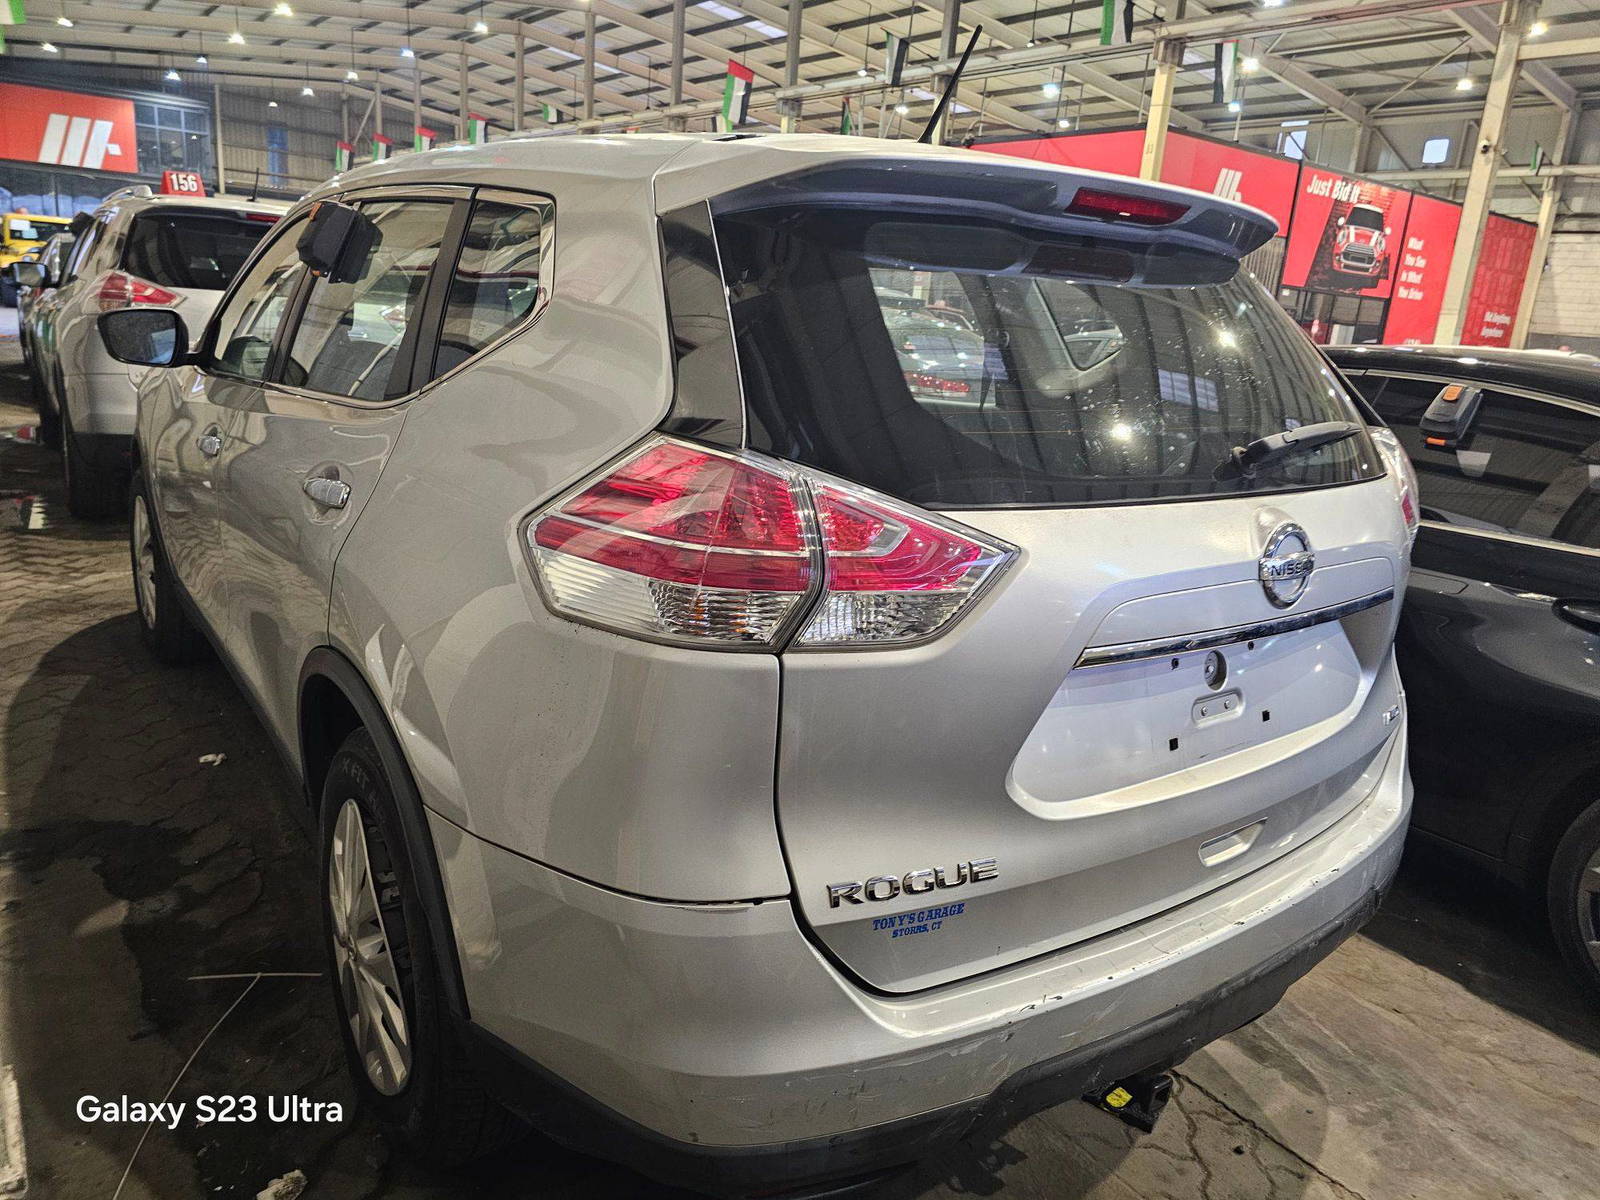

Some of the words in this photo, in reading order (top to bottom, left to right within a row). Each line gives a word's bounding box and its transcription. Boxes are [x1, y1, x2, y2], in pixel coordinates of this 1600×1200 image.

[170, 173, 198, 192] 156
[1307, 175, 1331, 197] Just
[1331, 180, 1352, 201] Bid
[827, 857, 998, 907] ROGUE
[872, 911, 915, 931] TONY'S
[917, 902, 965, 922] GARAGE
[892, 923, 929, 938] STORRS,
[931, 921, 943, 931] CT
